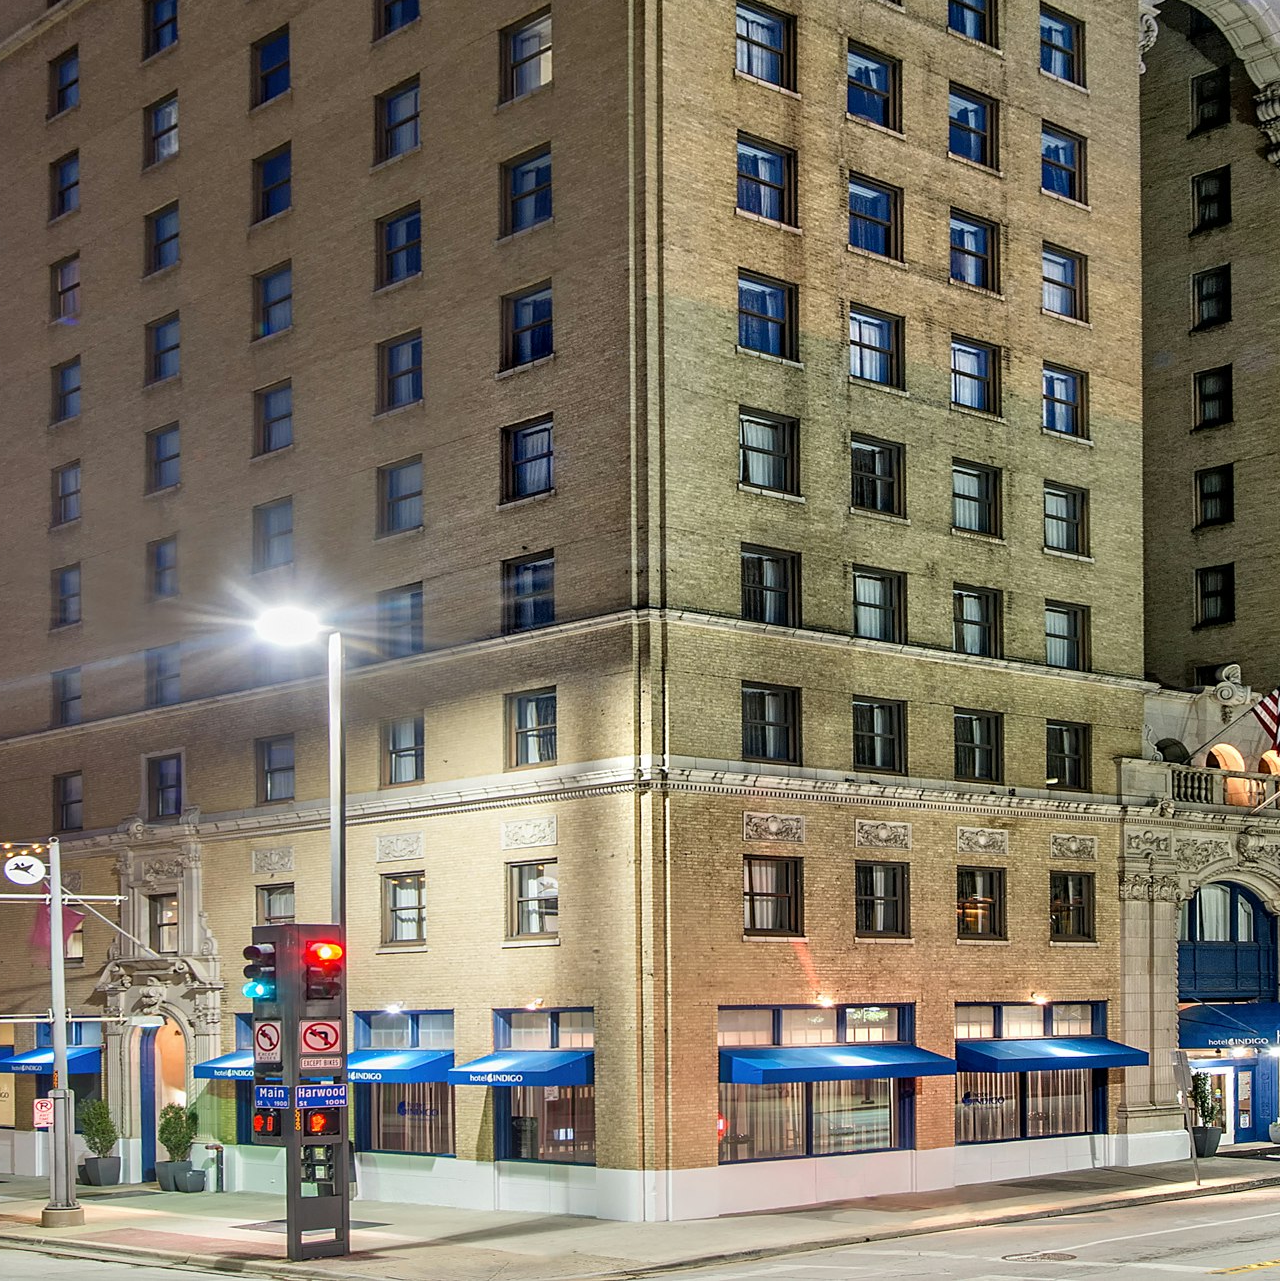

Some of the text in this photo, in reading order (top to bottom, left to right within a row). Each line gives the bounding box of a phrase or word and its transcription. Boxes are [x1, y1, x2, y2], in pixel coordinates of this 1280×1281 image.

[1235, 1037, 1268, 1045] INDIGO
[355, 1072, 382, 1080] INDIGO
[470, 1073, 523, 1082] hotel INDIGO
[260, 1087, 284, 1098] Main
[298, 1086, 345, 1098] Harwood
